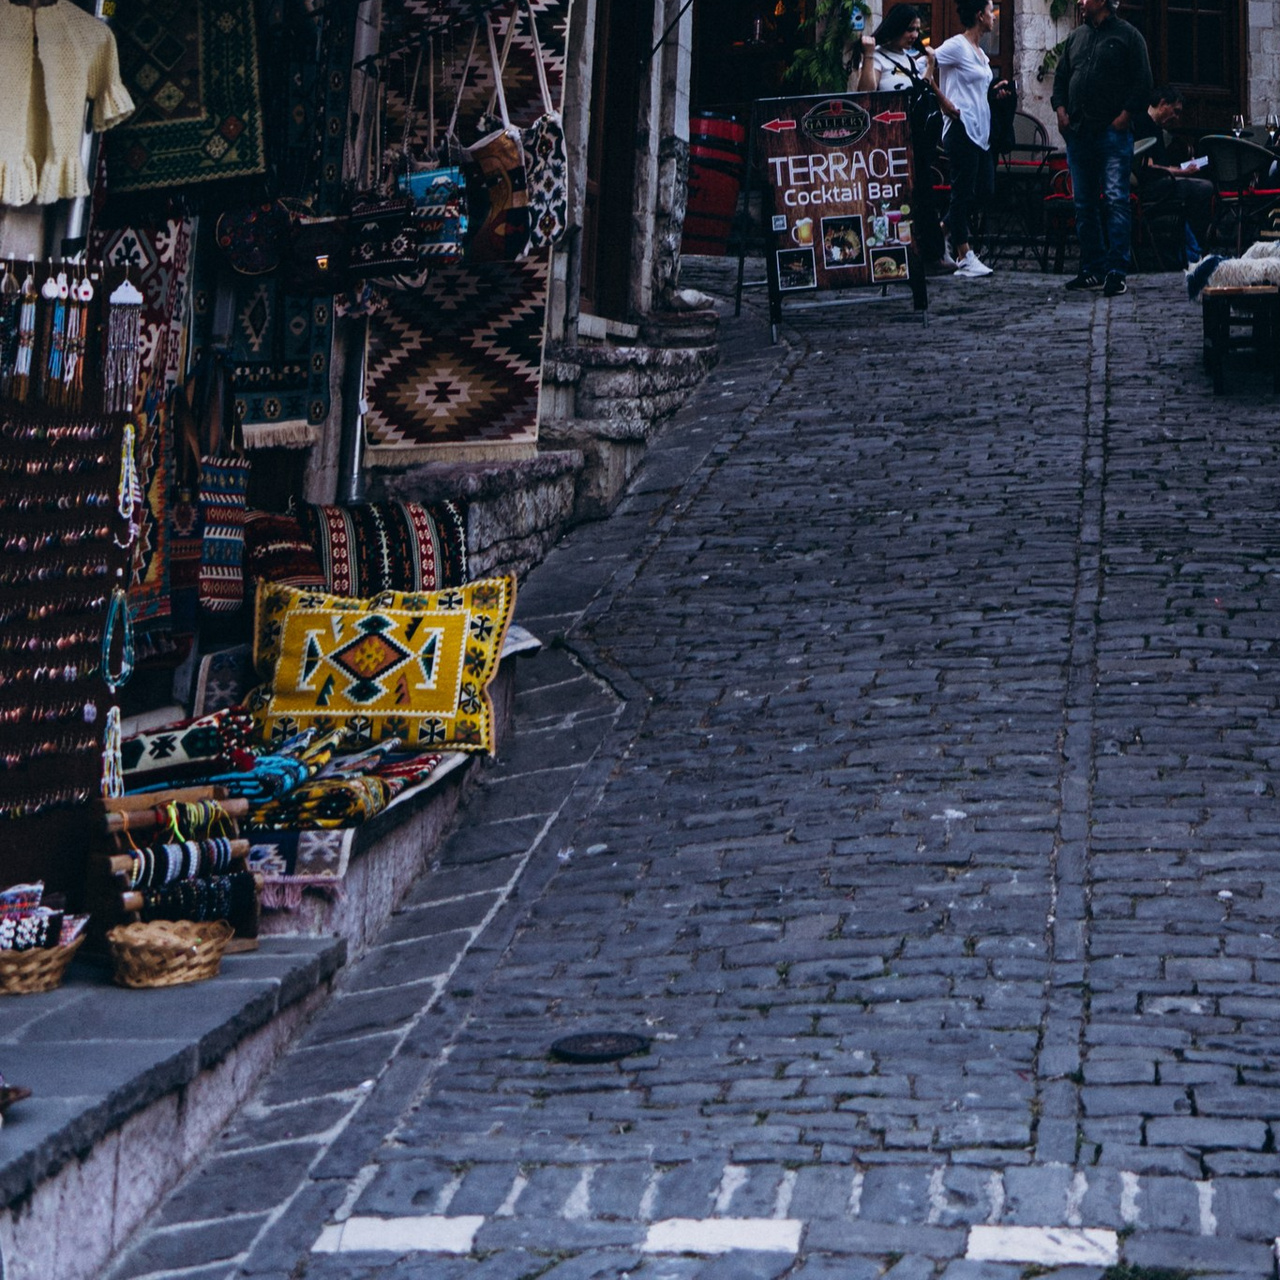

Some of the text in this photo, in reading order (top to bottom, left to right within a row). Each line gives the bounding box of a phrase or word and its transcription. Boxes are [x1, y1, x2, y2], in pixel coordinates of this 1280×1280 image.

[768, 147, 909, 187] TERRACE
[784, 182, 902, 207] Cocktail Bar
